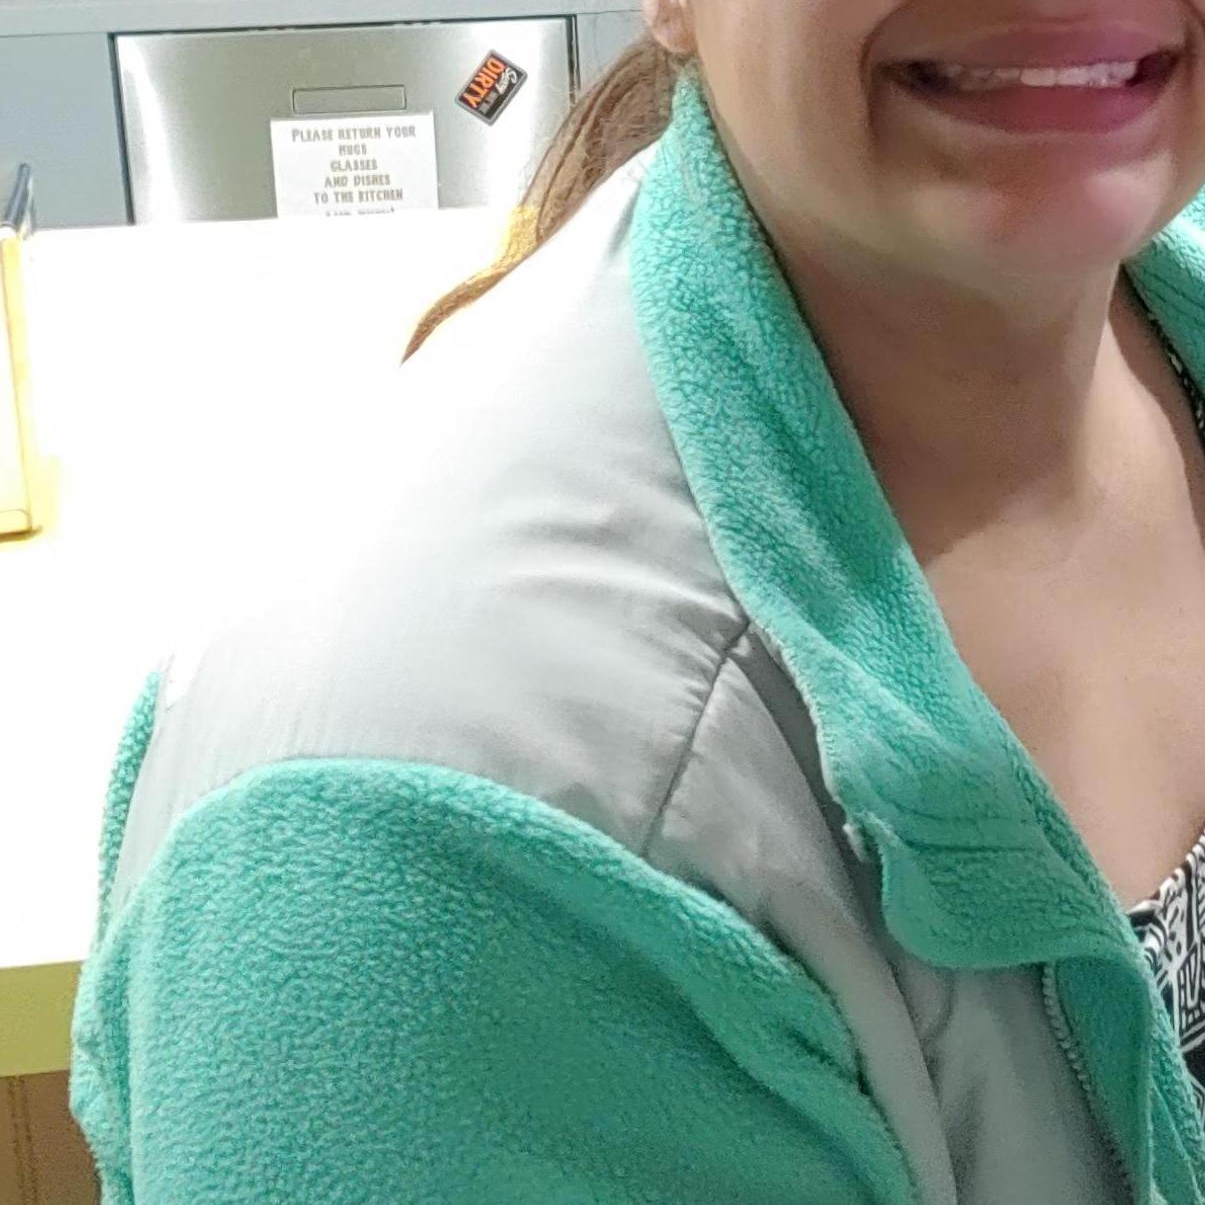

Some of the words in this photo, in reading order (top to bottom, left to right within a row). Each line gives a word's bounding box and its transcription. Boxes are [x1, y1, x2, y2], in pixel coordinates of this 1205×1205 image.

[463, 57, 507, 109] DIRTY
[291, 128, 334, 143] PLEASE
[338, 126, 381, 140] RETURN
[386, 125, 416, 138] YOUR
[338, 143, 367, 156] MUGS
[330, 159, 378, 172] GLASSES
[324, 175, 348, 189] AND
[353, 174, 391, 187] DISHES
[313, 192, 329, 205] TO
[334, 190, 354, 203] THE
[358, 188, 403, 203] KITCHEN
